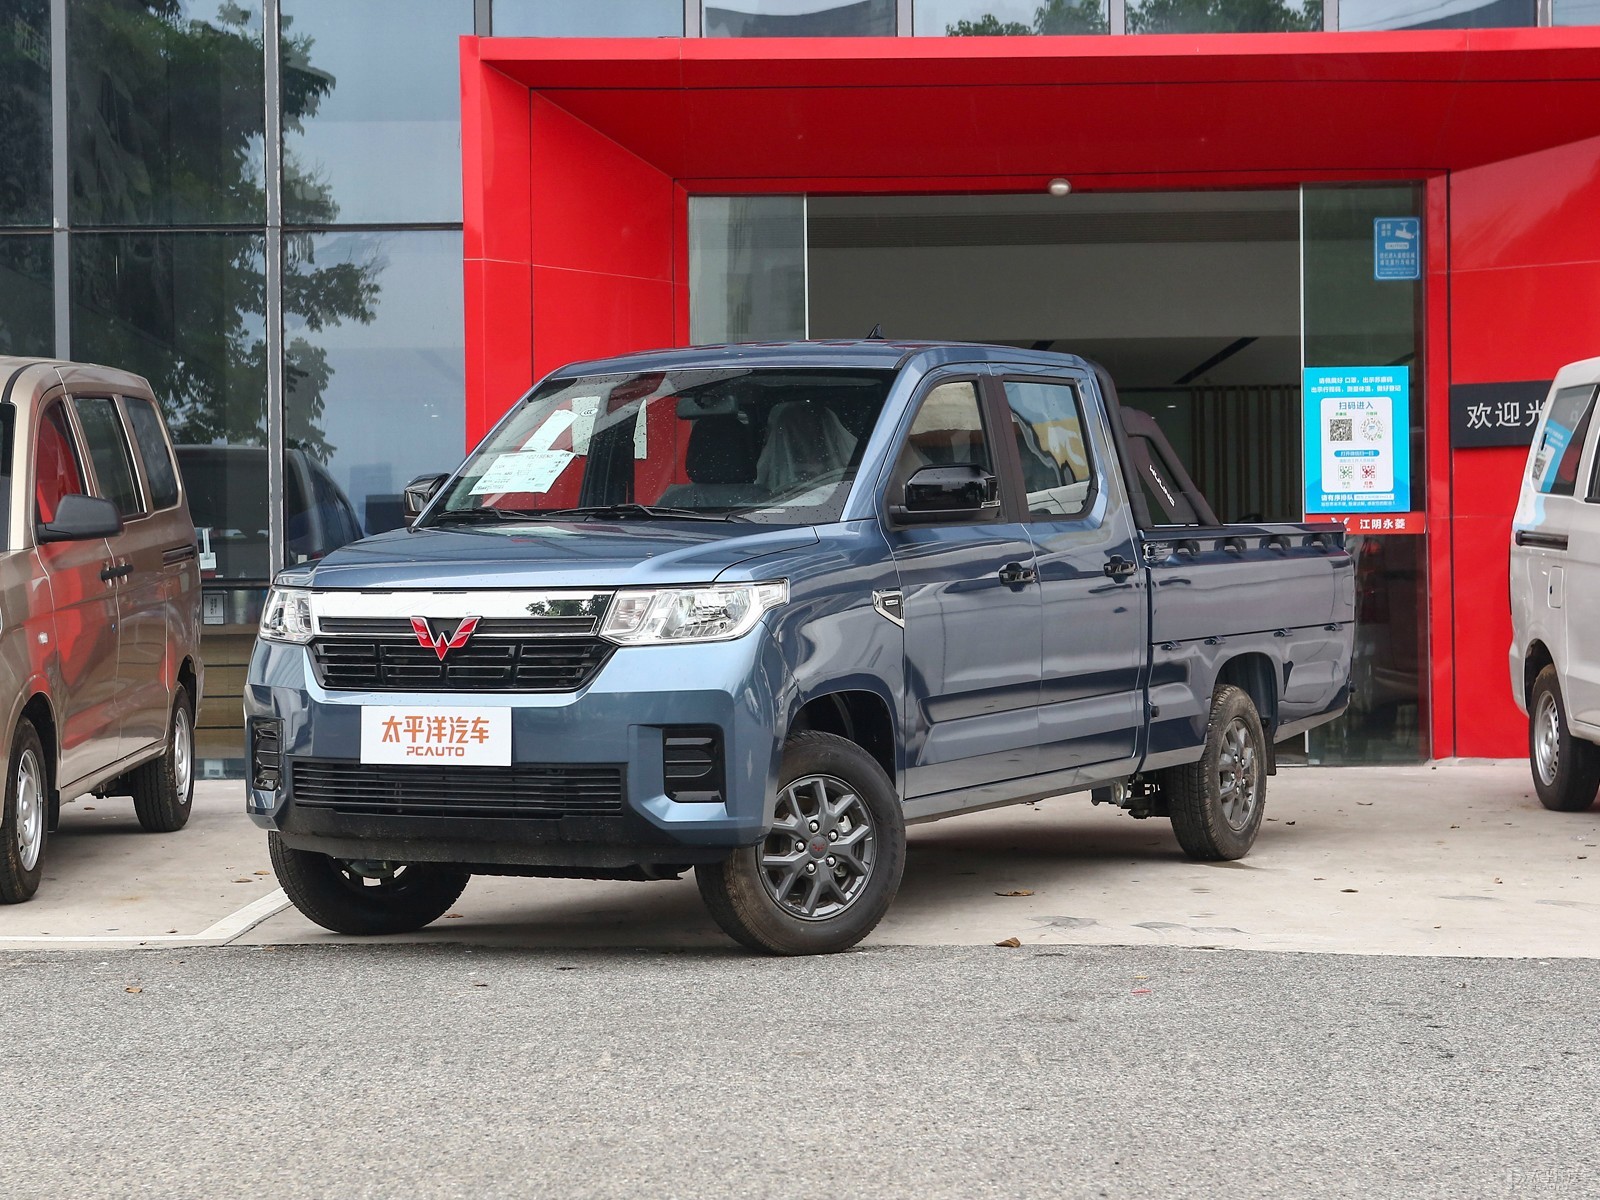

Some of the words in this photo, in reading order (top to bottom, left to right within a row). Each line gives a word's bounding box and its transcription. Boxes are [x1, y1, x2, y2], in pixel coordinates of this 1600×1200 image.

[1339, 401, 1373, 410] 扫码进入
[1360, 518, 1405, 529] 江阴永菱
[381, 715, 490, 744] 太平洋汽车
[406, 746, 465, 756] PCAUTO
